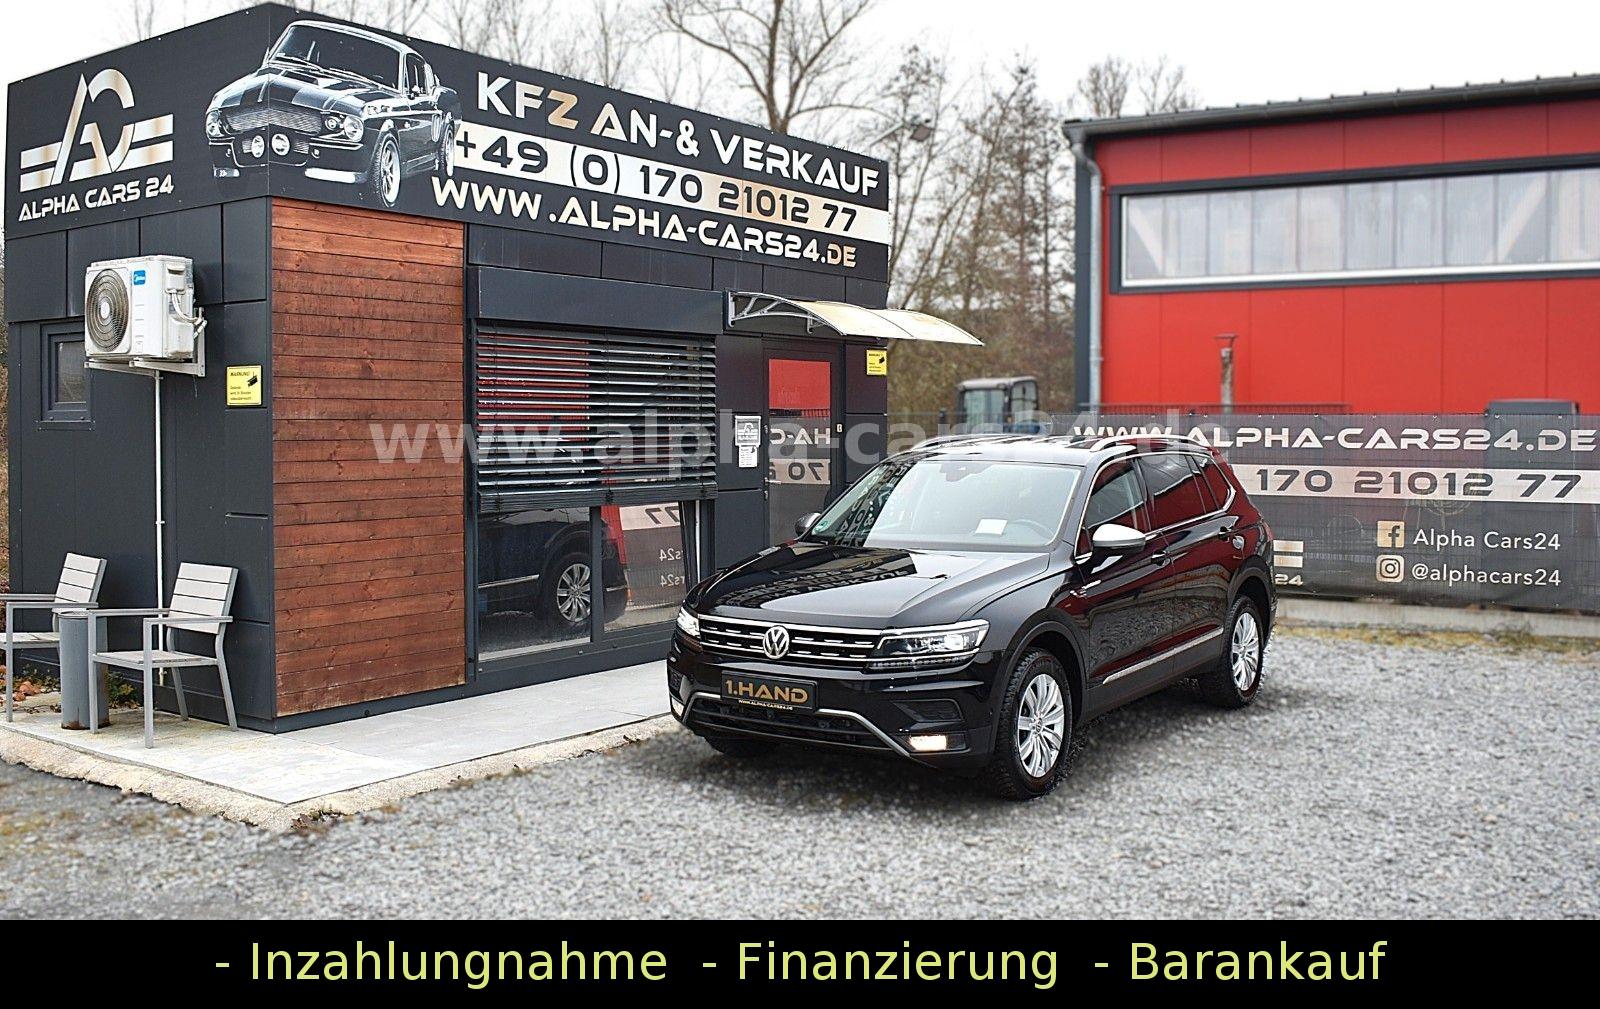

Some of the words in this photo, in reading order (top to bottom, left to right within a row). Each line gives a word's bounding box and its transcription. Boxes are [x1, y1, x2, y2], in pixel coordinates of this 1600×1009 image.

[477, 71, 579, 130] KFZ
[709, 128, 880, 197] VERKAUF
[456, 130, 549, 174] +49
[570, 145, 621, 194] (0)
[639, 165, 703, 204] 170
[718, 181, 810, 224] 21012
[822, 203, 857, 232] 77
[18, 193, 81, 222] ALPHA
[84, 180, 141, 209] CARS
[145, 174, 175, 198] 24
[1256, 468, 1333, 492] 170
[1353, 471, 1494, 497] 21012
[1516, 473, 1583, 499] 77
[1412, 529, 1476, 552] Alpha
[1483, 530, 1562, 551] Cars24
[1411, 563, 1562, 587] @alphacars24
[725, 679, 810, 704] 1.HAND
